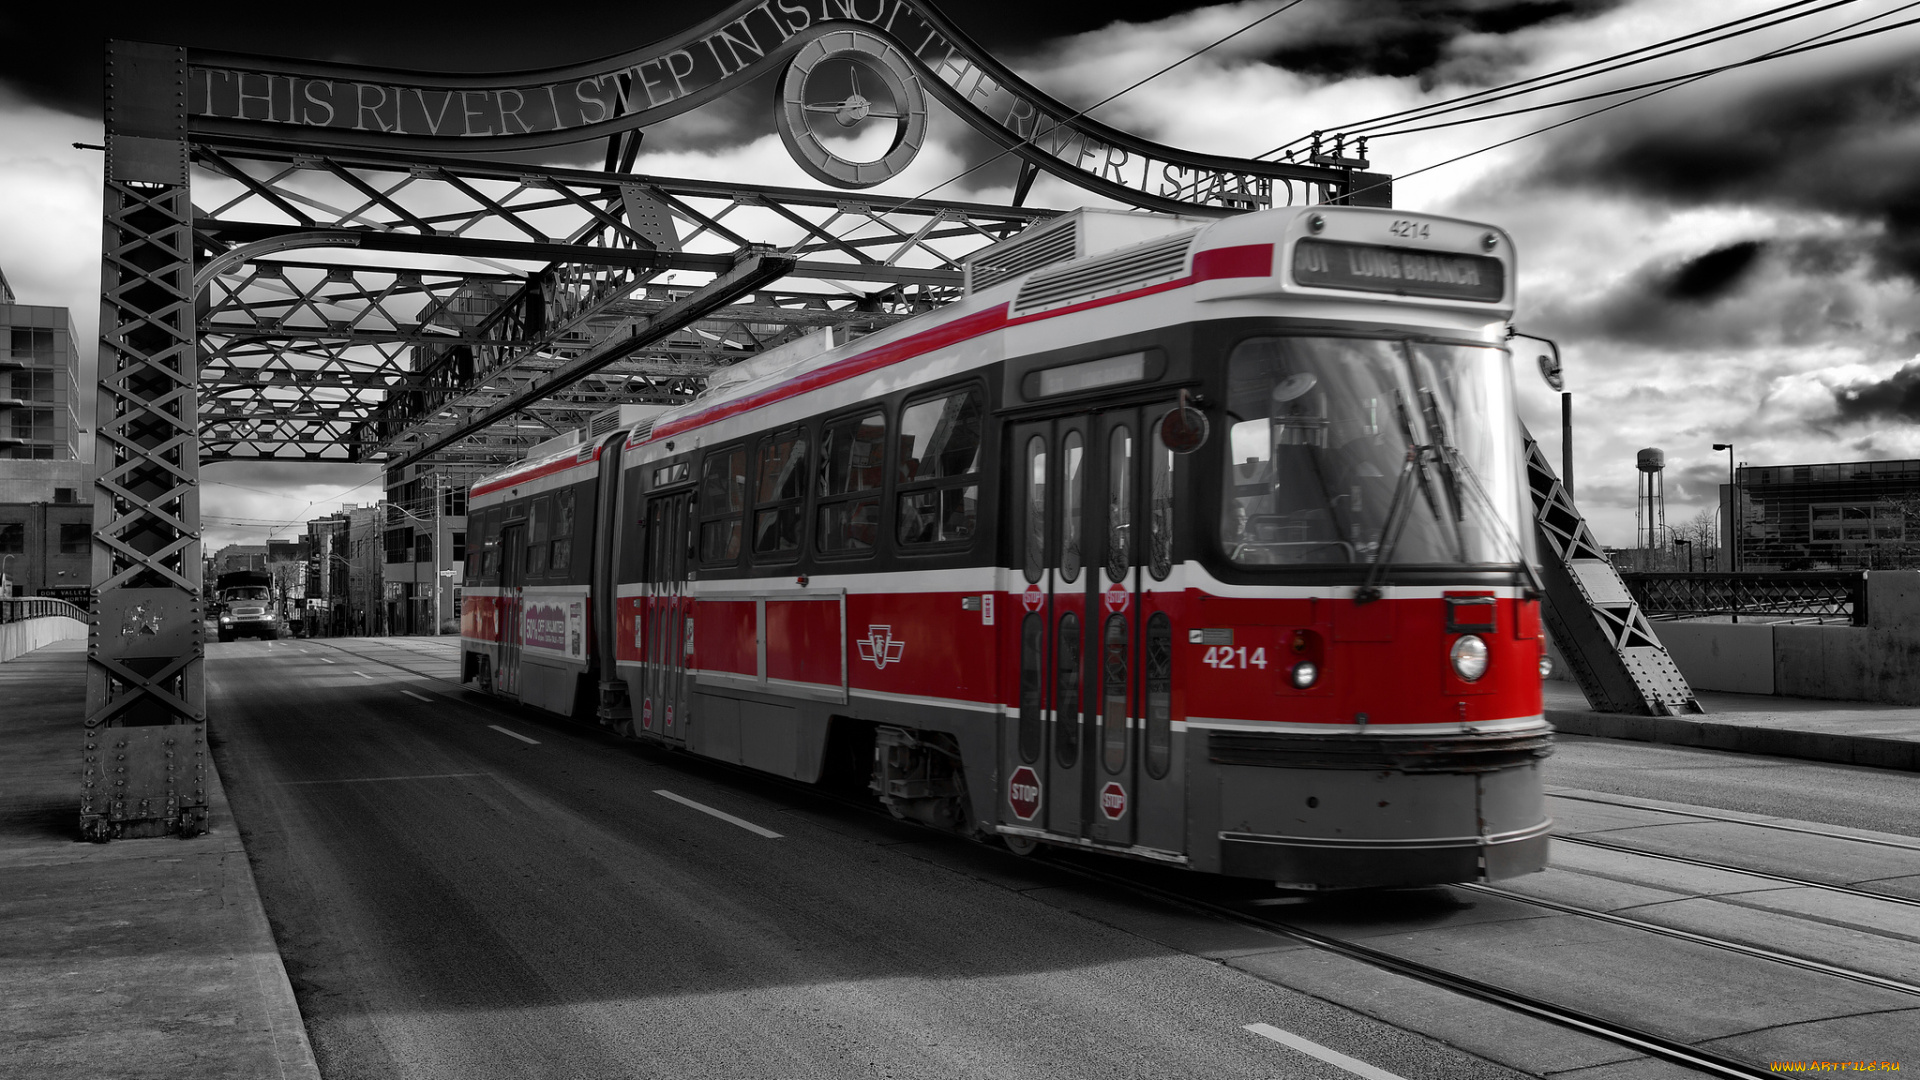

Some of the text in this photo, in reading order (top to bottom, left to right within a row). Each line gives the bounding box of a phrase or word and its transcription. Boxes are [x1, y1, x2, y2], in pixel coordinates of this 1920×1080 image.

[188, 66, 335, 127] THIS
[352, 83, 534, 138] RIVER
[537, 83, 569, 132] I
[575, 50, 694, 125] STEP
[700, 15, 766, 79] IN
[757, 0, 812, 43] IS
[914, 19, 1001, 112] THE
[1003, 95, 1128, 186] RIVER
[1139, 156, 1152, 192] I
[1389, 219, 1431, 240] 4214
[1348, 250, 1402, 279] LONG
[1024, 591, 1041, 604] STOP
[1107, 590, 1128, 604] STOP
[1202, 645, 1269, 670] 4214
[1011, 783, 1039, 803] STOP
[1103, 793, 1124, 809] STOP
